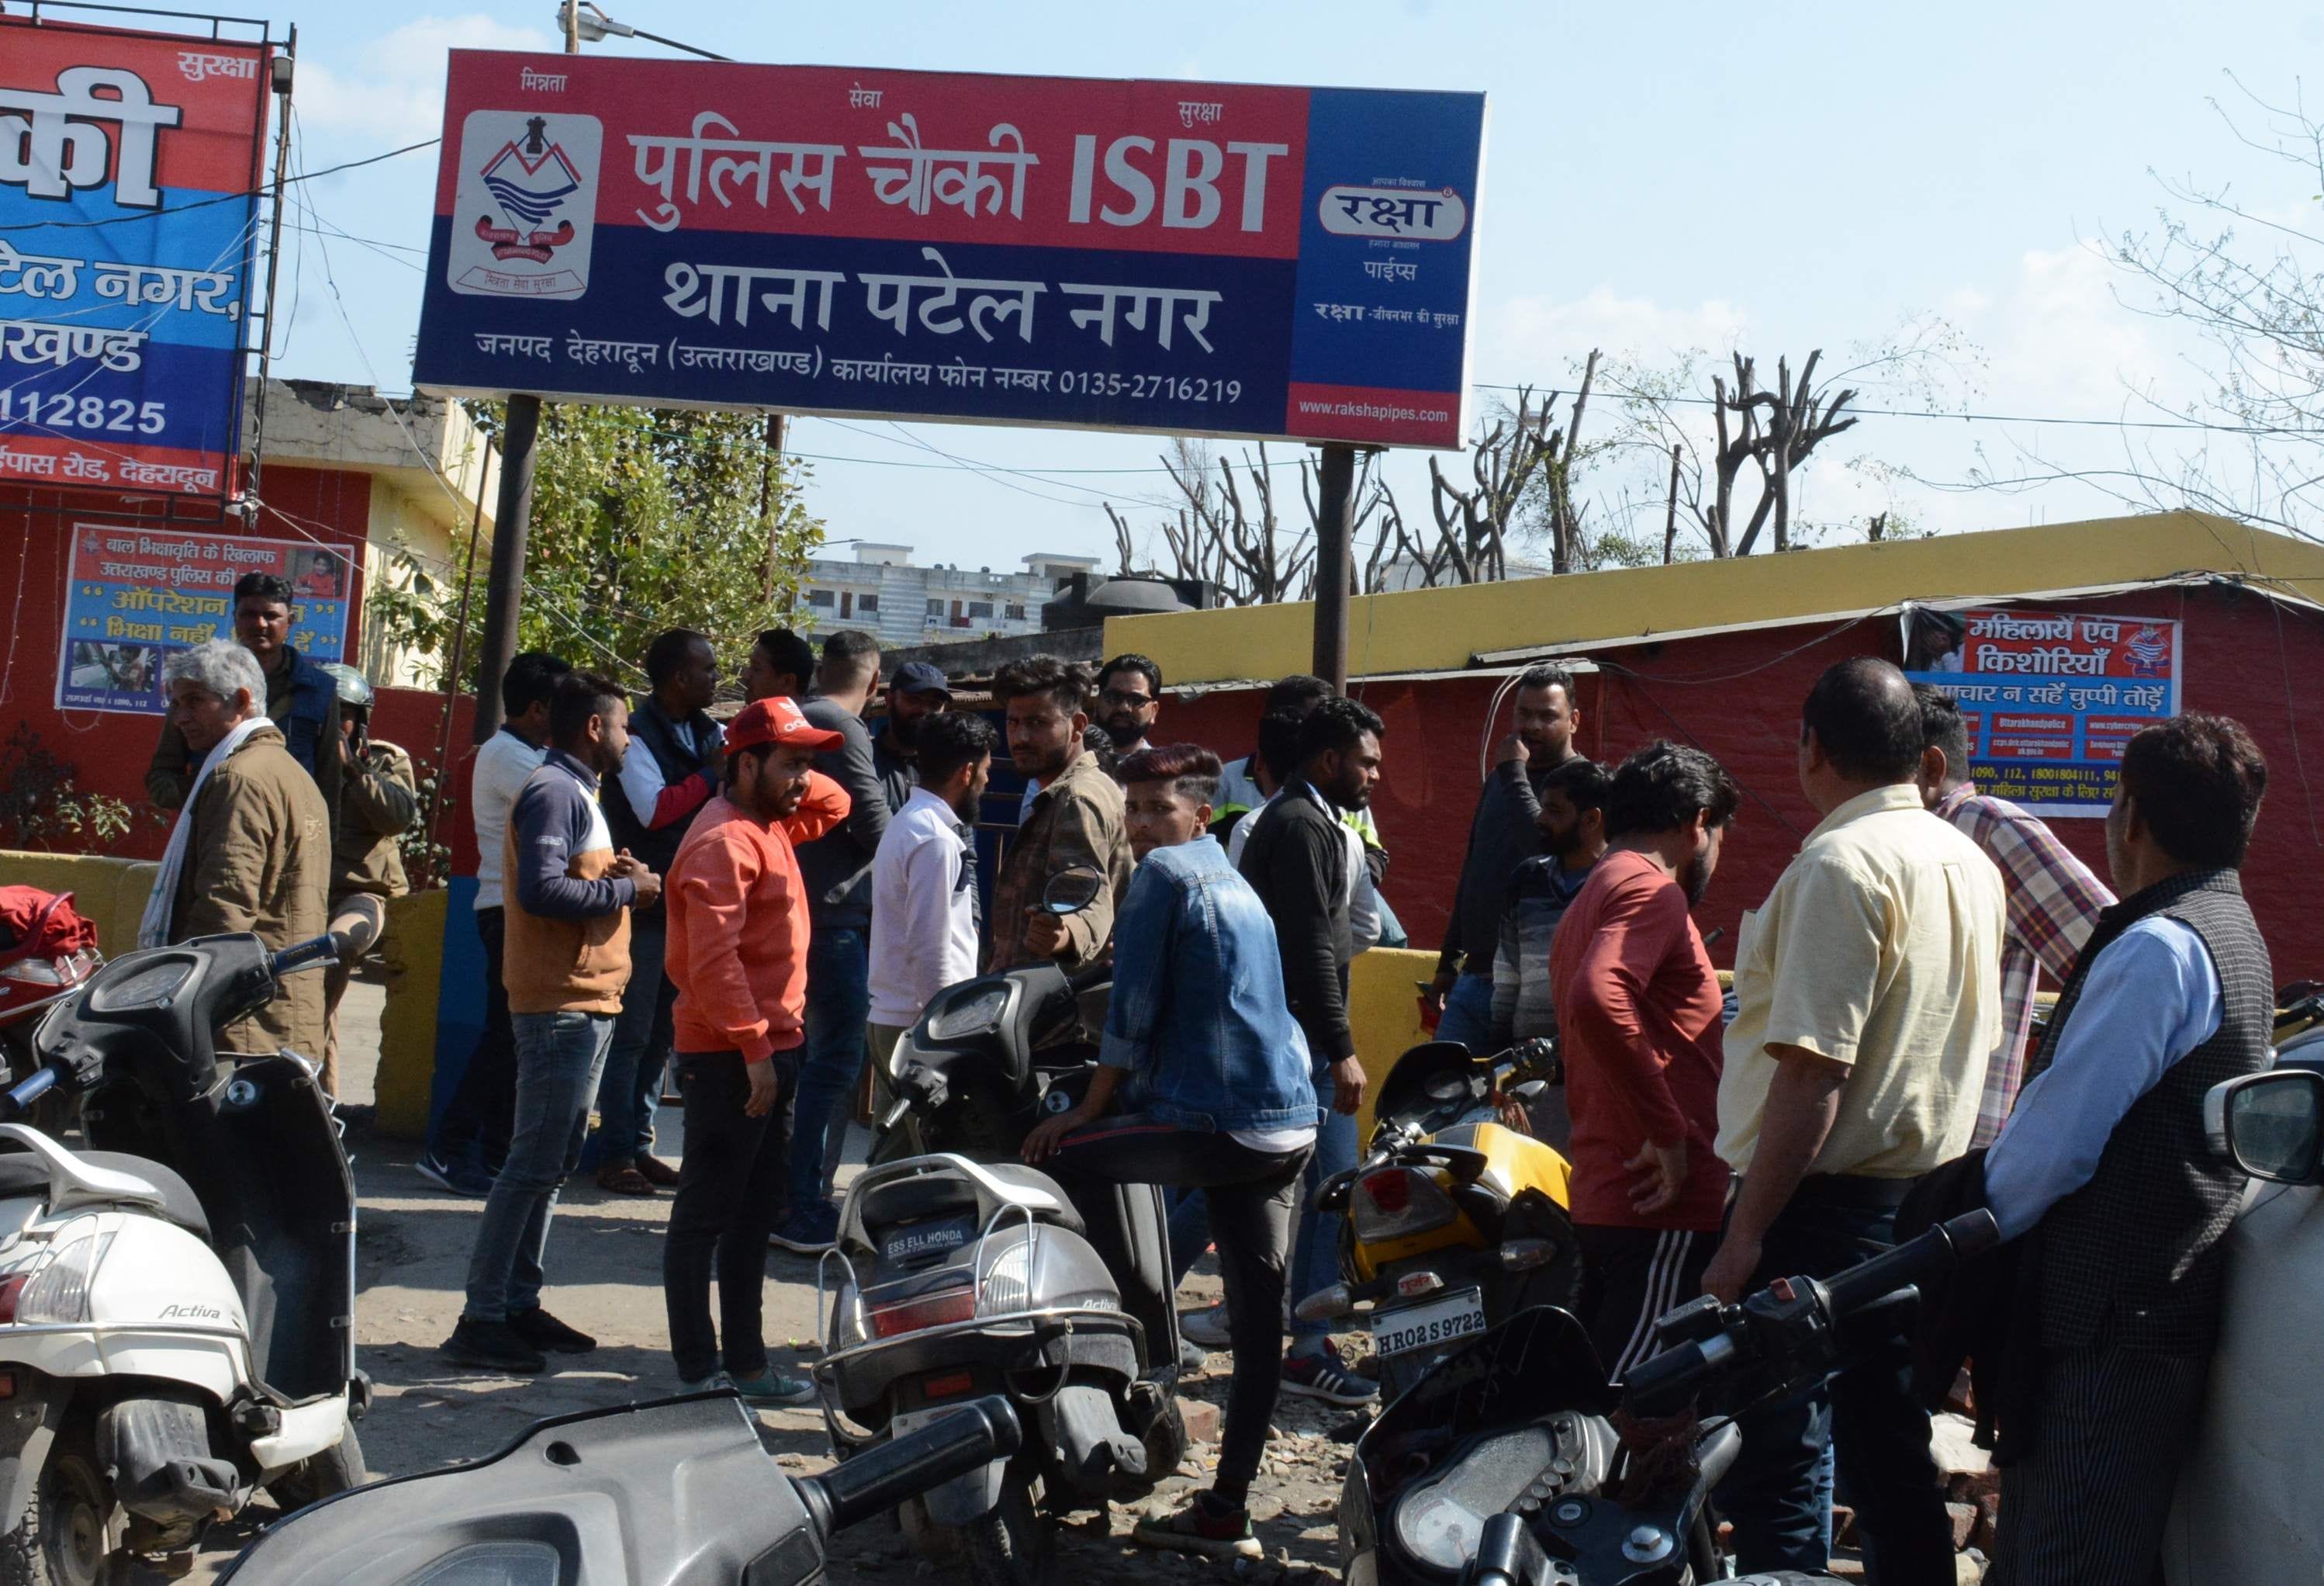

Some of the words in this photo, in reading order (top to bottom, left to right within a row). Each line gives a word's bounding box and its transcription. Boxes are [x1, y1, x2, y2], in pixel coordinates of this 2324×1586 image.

[178, 52, 258, 81] सुरक्षा
[849, 81, 883, 109] सेवा
[1178, 102, 1223, 128] सुरक्षा
[627, 111, 846, 232] पुलिस
[857, 113, 1040, 221] चौकी
[1068, 135, 1288, 233] ISBT
[1335, 195, 1443, 233] रक्षा
[1364, 257, 1418, 282] पाईप्स
[94, 261, 241, 322] नगर,
[662, 262, 846, 332] थाना
[857, 247, 1047, 344] पटेल
[1059, 282, 1223, 353] नगर
[1314, 303, 1365, 322] रक्षा
[1433, 313, 1459, 328] सुरक्षा
[475, 333, 552, 363] जनपद
[566, 329, 659, 374] देहरादून
[668, 337, 821, 379] (उत्तराखण्ड)
[831, 353, 932, 385] कार्यालय
[937, 356, 987, 388] फोन
[992, 367, 1053, 393] नम्बर
[1060, 370, 1241, 403] 0135-2716219
[1299, 401, 1447, 422] www.rakshapipes.com
[62, 452, 110, 482] रोड,
[119, 457, 217, 493] देहरादून
[106, 538, 136, 553] बाल
[203, 543, 219, 559] के
[223, 543, 277, 564] खिलाफ
[170, 564, 212, 587] पुलिस
[215, 567, 236, 586] की
[1976, 644, 2111, 675] किशोरियाँ
[2002, 686, 2022, 702] न
[2028, 683, 2066, 704] सहें
[2069, 684, 2118, 711] चुप्पी
[2123, 685, 2166, 712] तोड़ें
[1990, 781, 2026, 796] महिला
[2029, 785, 2059, 802] सुरक्षा
[2063, 783, 2073, 797] के
[2077, 783, 2100, 798] लिए
[888, 1240, 904, 1255] ESS
[907, 1235, 925, 1248] ELL
[927, 1230, 963, 1243] HONDA
[157, 1304, 221, 1319] Activa
